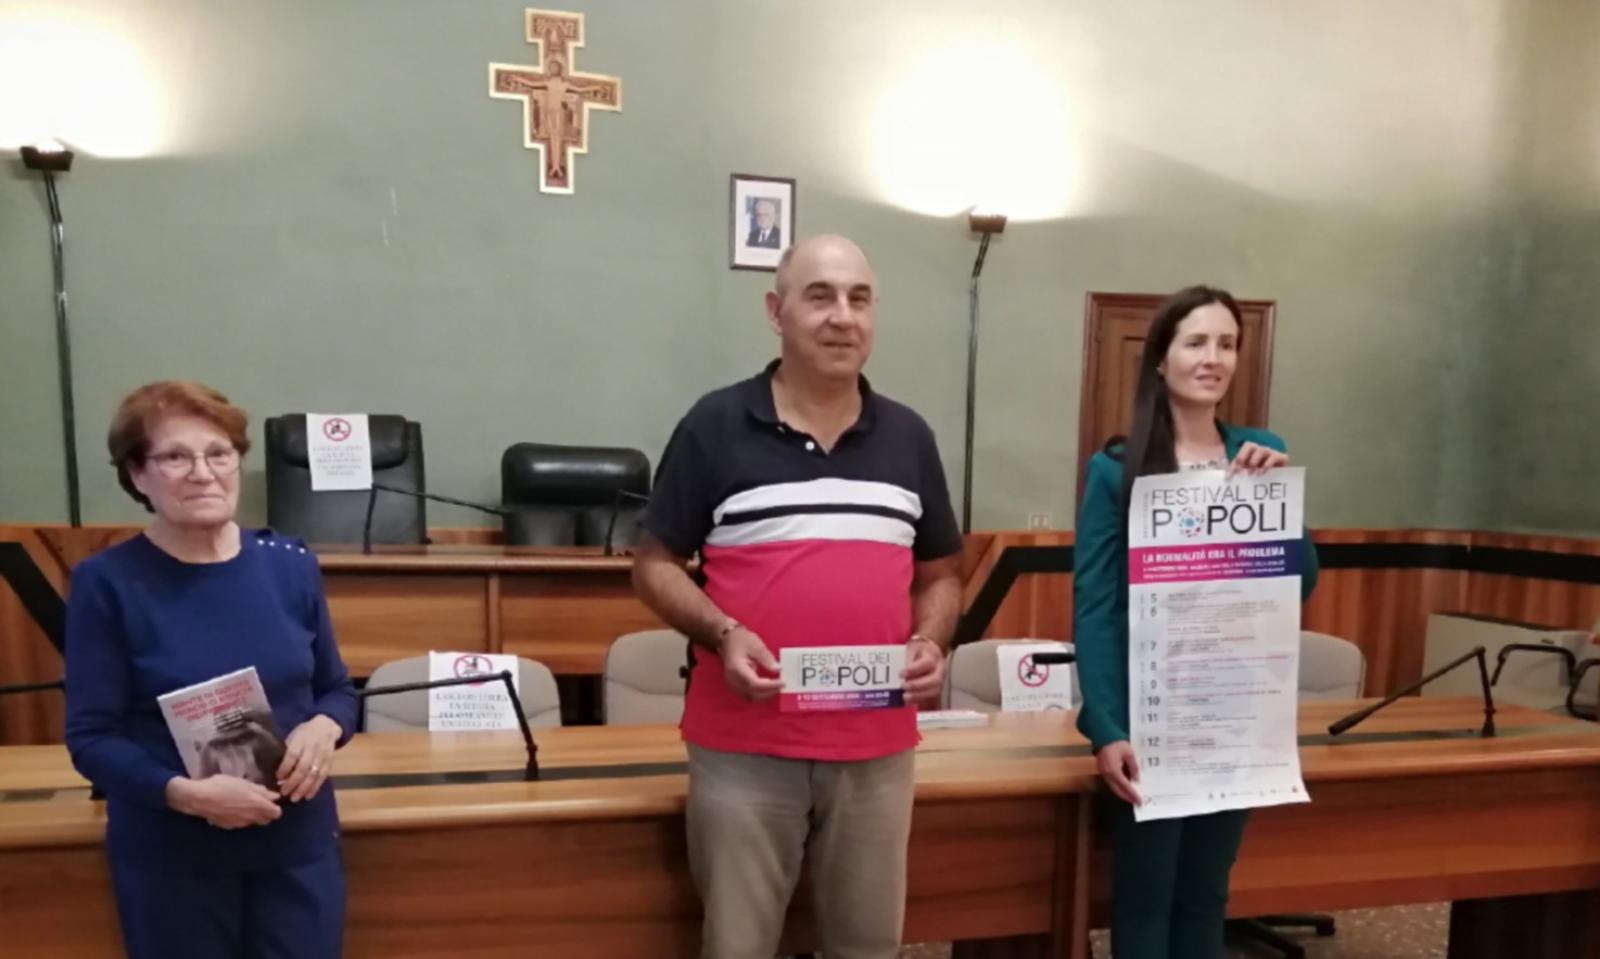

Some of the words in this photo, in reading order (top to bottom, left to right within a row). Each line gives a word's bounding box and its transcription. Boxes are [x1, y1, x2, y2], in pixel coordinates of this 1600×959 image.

[1151, 485, 1246, 507] FESTIVAL
[1253, 482, 1287, 501] DEI
[1142, 553, 1154, 564] LA
[1150, 593, 1158, 604] 5
[1150, 607, 1157, 618] 6
[1150, 641, 1157, 651] 7
[801, 652, 864, 667] FESTIVAL
[868, 652, 890, 665] DEI
[1147, 696, 1160, 706] 10
[1147, 713, 1158, 723] 11
[1147, 737, 1160, 747] 12
[1147, 757, 1160, 767] 13
